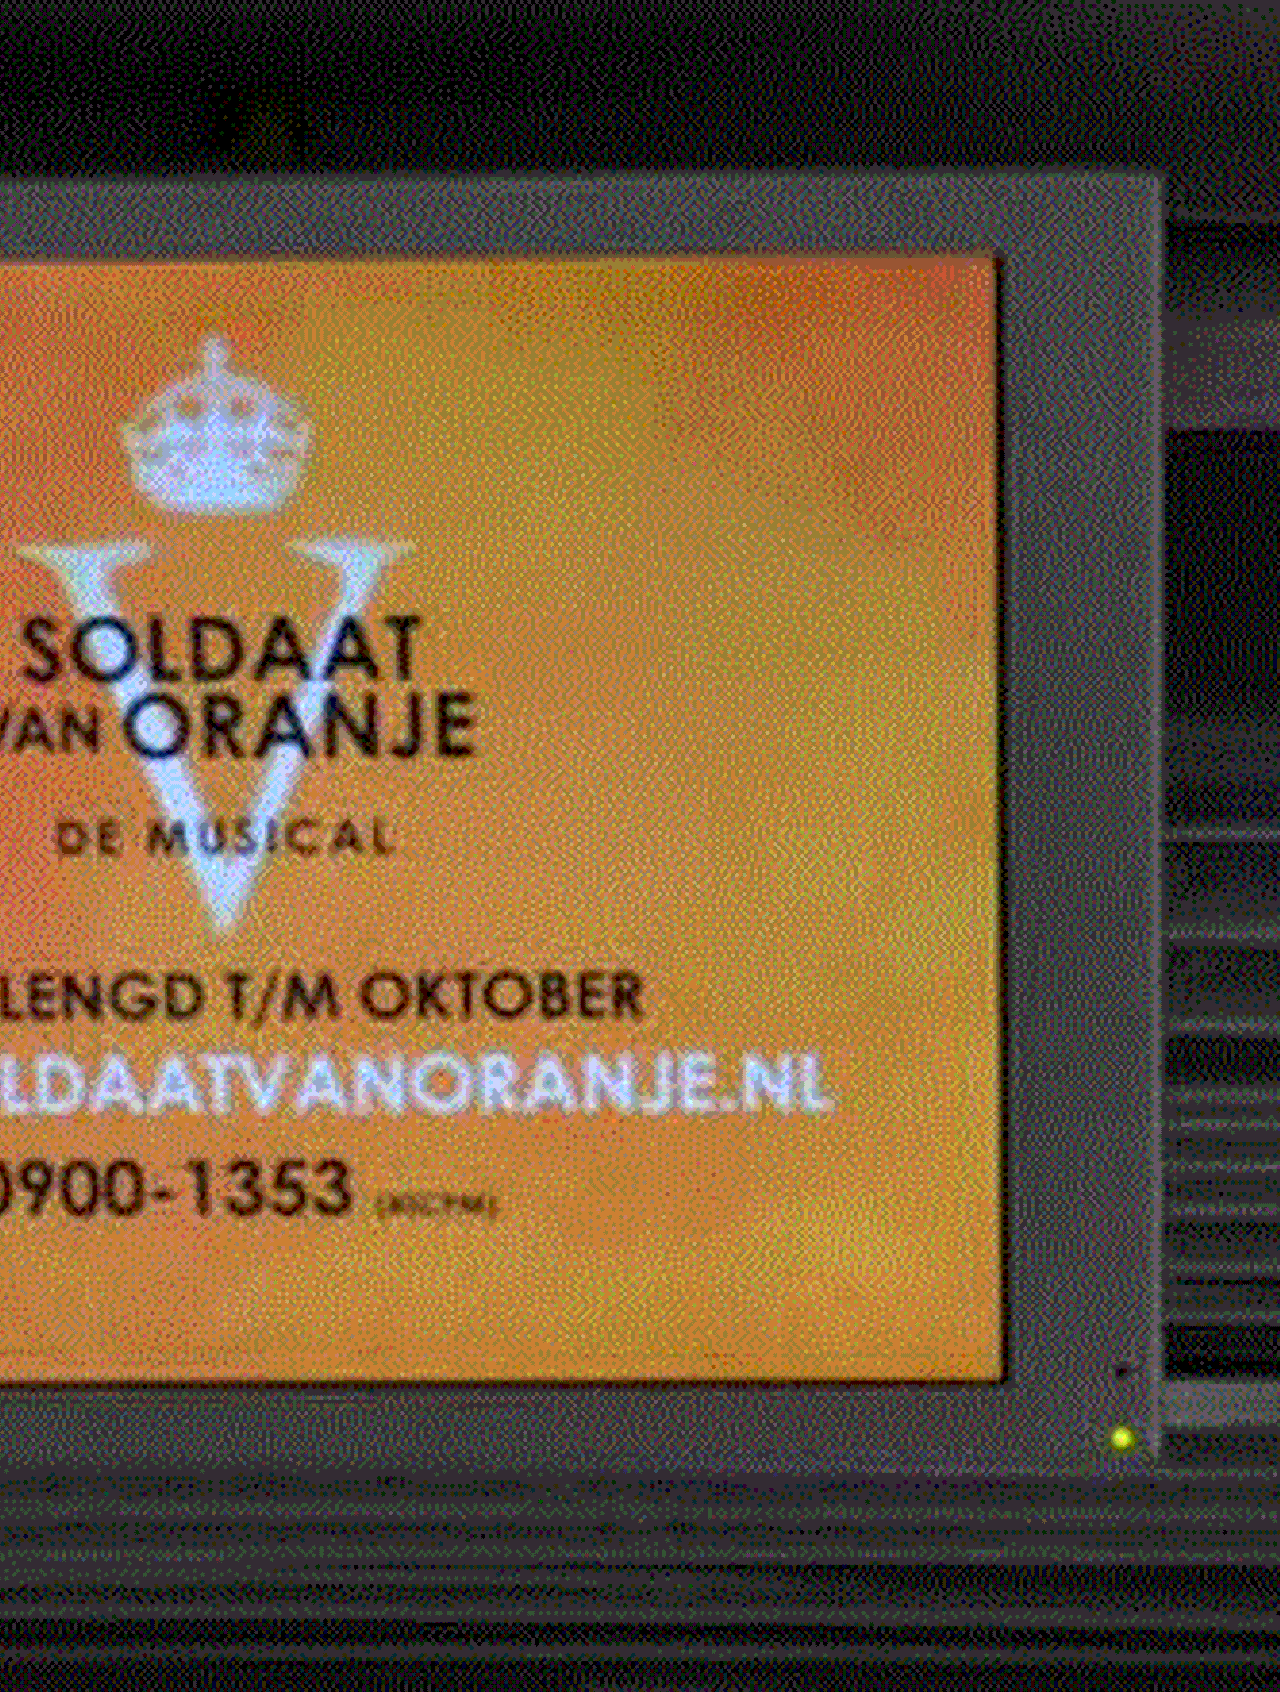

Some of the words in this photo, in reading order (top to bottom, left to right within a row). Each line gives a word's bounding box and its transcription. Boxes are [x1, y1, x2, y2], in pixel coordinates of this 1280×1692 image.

[22, 614, 421, 684] SOLDAAT
[124, 691, 476, 759] ORANJE
[54, 819, 122, 858] DE
[145, 816, 398, 858] MUSICAL
[225, 970, 340, 1029] T/M
[359, 968, 644, 1020] OKTOBER
